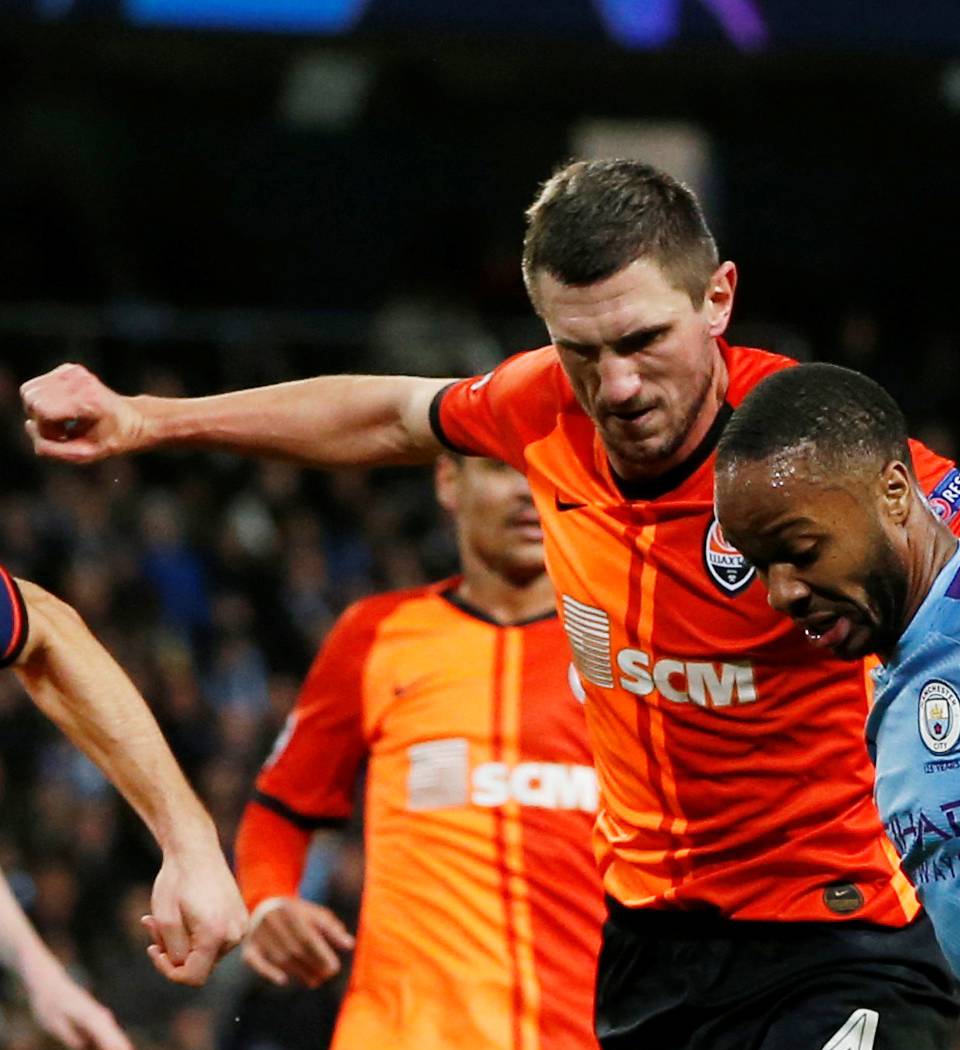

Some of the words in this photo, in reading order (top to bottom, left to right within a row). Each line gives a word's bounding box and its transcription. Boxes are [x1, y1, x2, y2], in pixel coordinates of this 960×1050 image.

[616, 648, 757, 707] SCM
[933, 742, 948, 750] CITY
[471, 761, 599, 813] SCM
